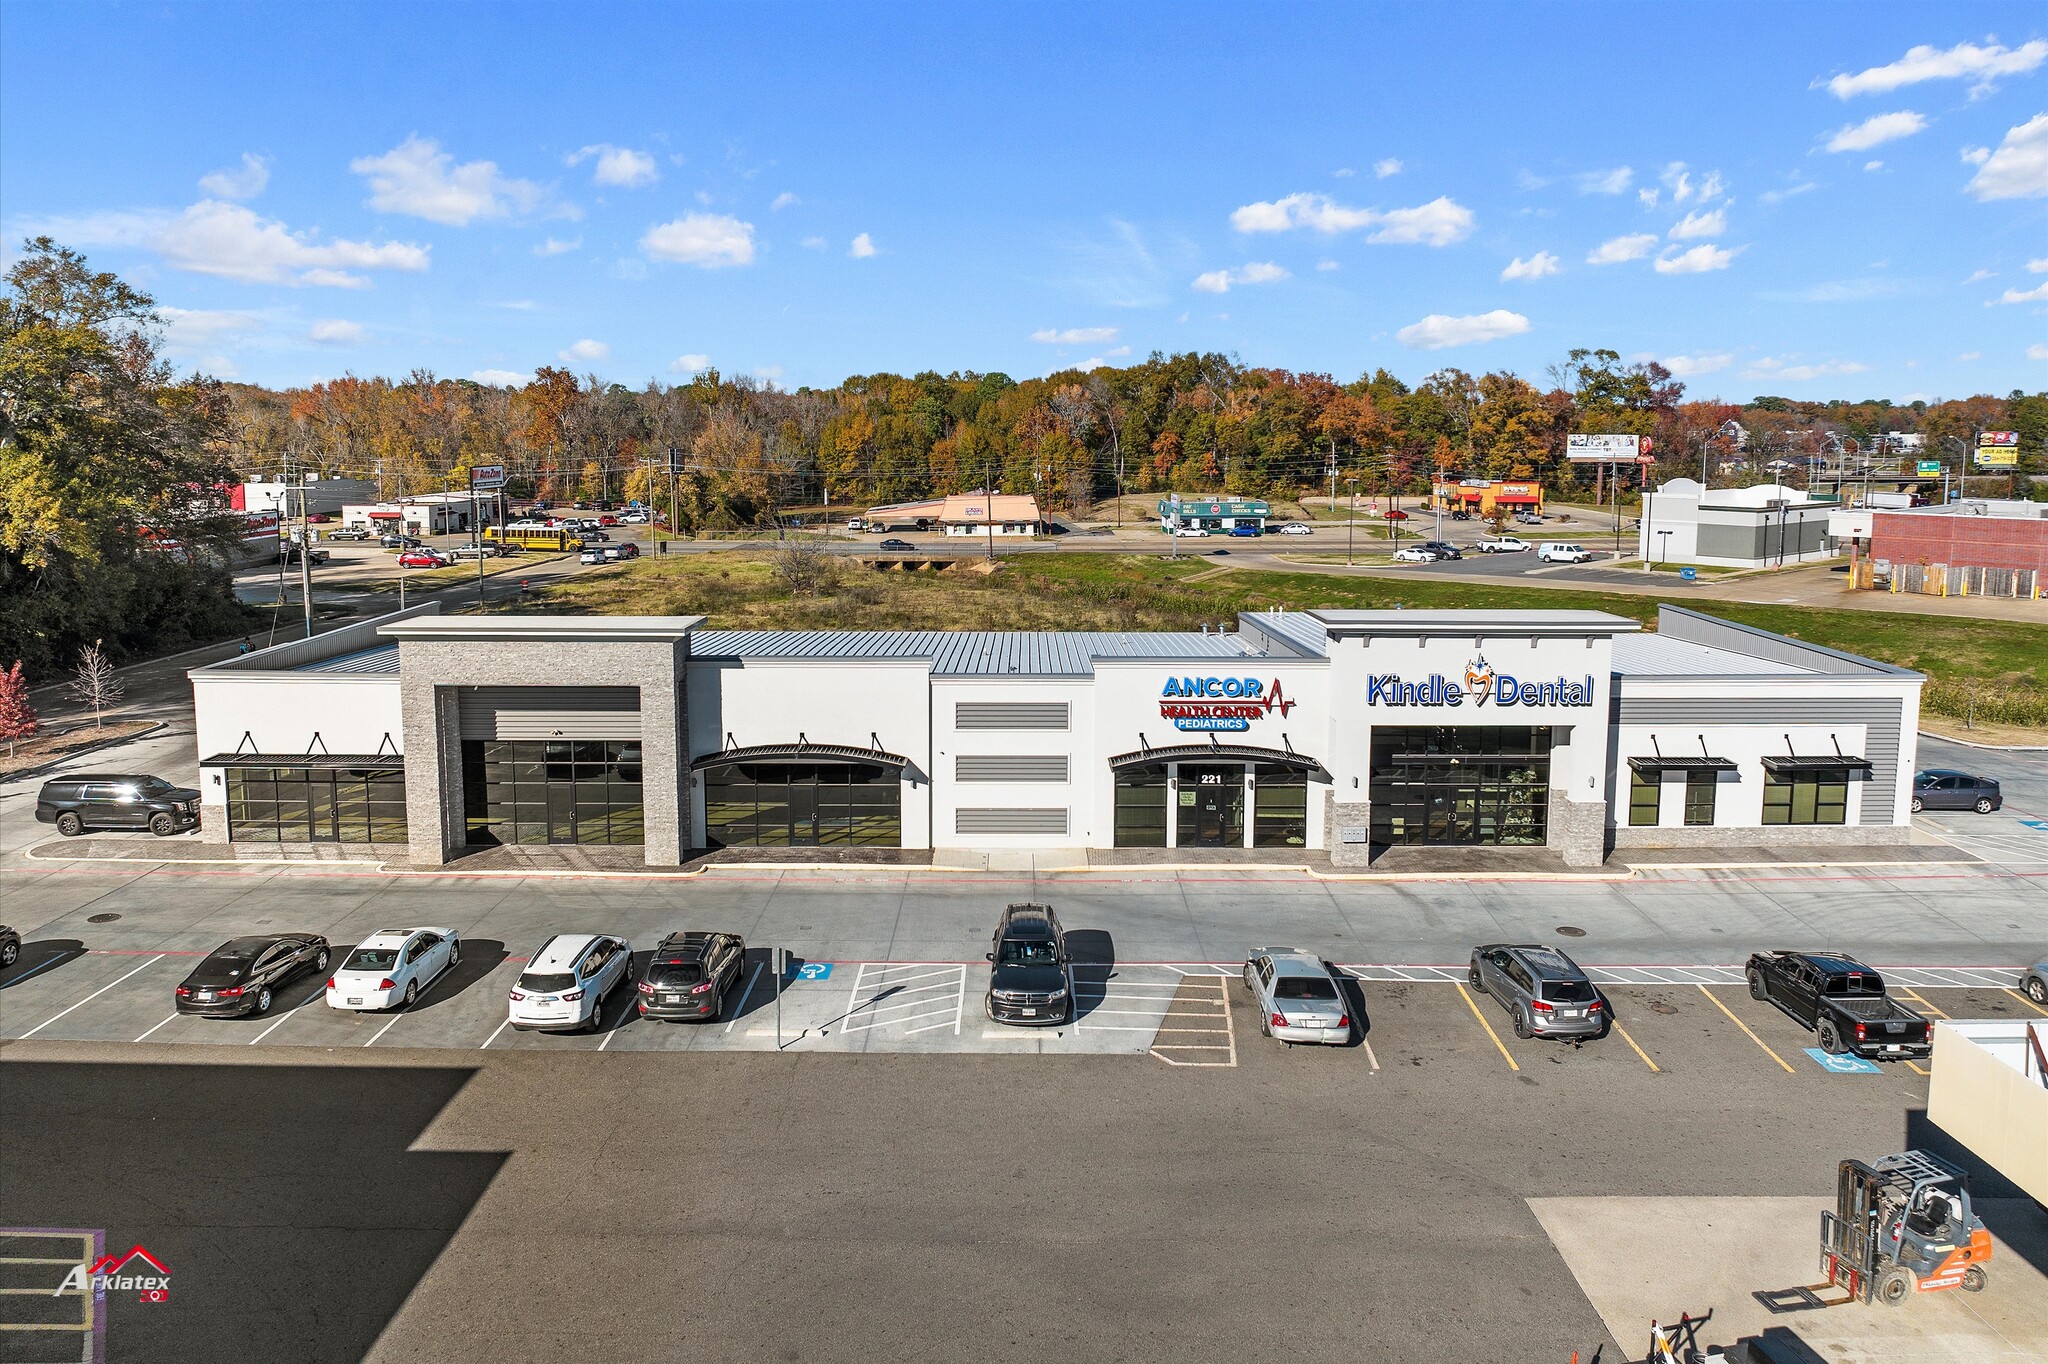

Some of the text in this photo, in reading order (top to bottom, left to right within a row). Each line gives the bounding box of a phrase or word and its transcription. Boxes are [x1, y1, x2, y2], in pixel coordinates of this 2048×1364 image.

[1161, 676, 1263, 698] ANCOR
[1366, 673, 1595, 707] Kindle Dental
[1160, 705, 1264, 719] HEALTH CENTER
[1178, 719, 1243, 728] PEDIATRICS
[1201, 774, 1221, 784] 221
